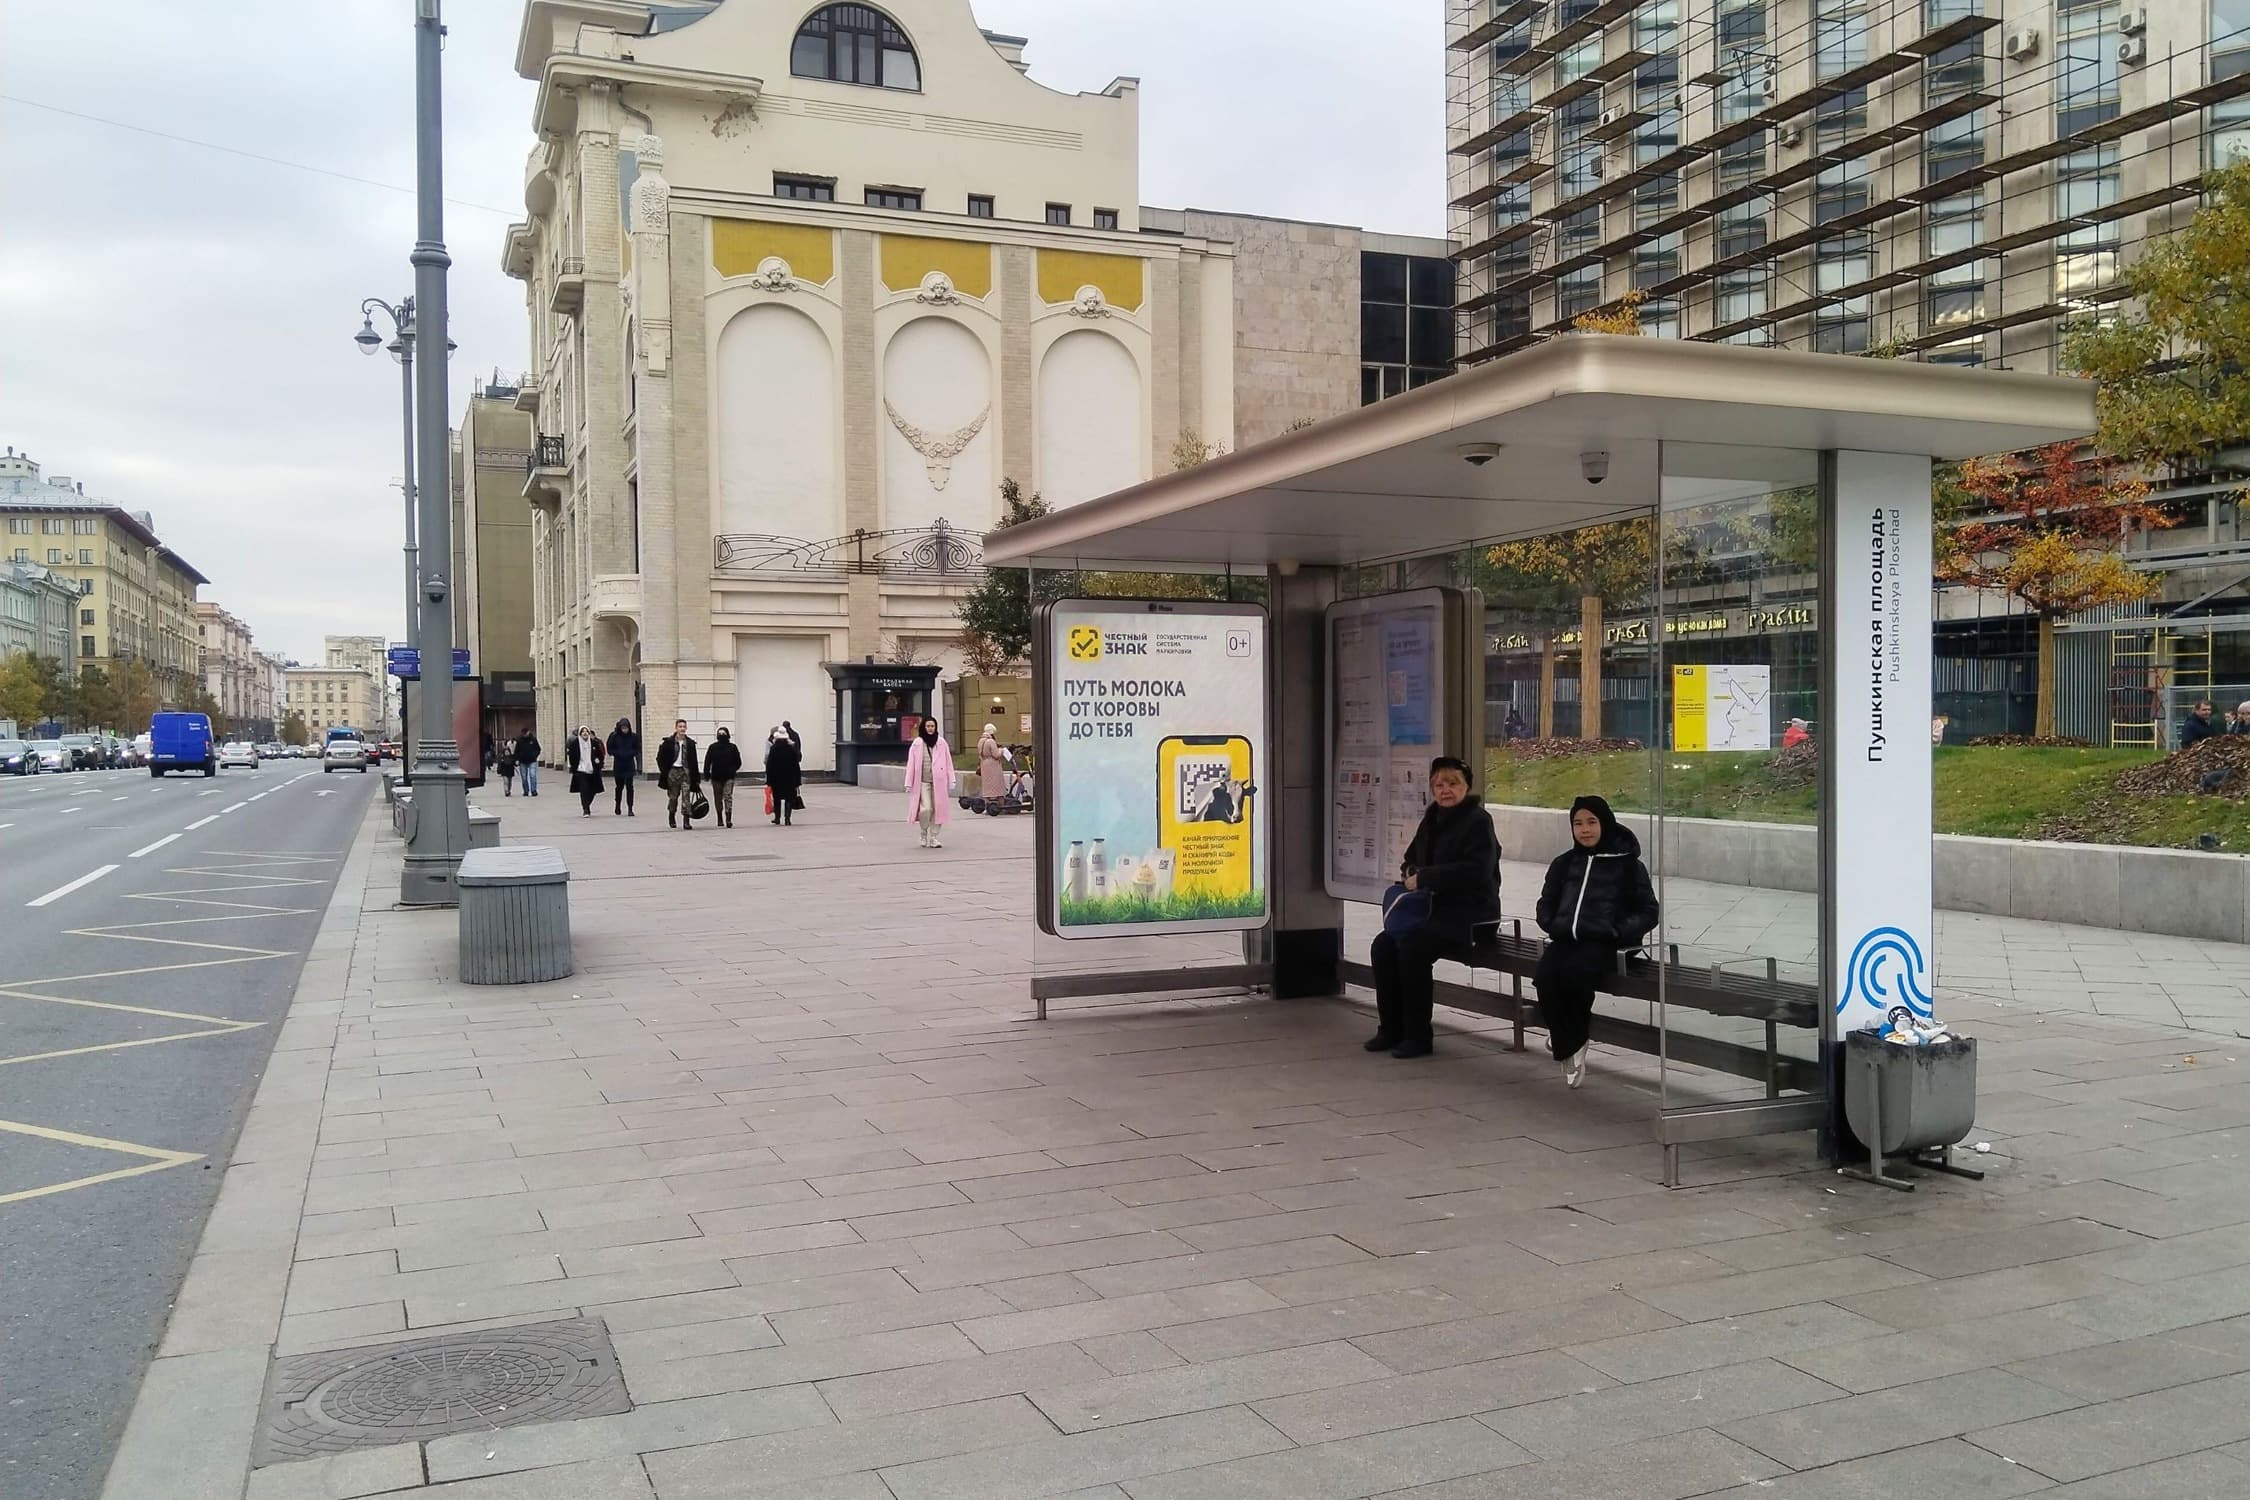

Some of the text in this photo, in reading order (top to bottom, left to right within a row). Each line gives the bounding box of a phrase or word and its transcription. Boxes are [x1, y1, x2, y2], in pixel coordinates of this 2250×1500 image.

[1888, 509, 1902, 682] Pushkinskaya Ploschad
[1104, 632, 1148, 641] ЧЕСТНЫЙ
[1868, 507, 1886, 762] Пушкинская площадь
[1104, 642, 1148, 655] ЗНАК
[1229, 636, 1248, 651] 0+
[1064, 679, 1186, 697] ПУТЬ МОЛОКА
[1069, 701, 1160, 717] ОТ КОРОВЫ
[1069, 722, 1133, 740] ДО ТЕБЯ
